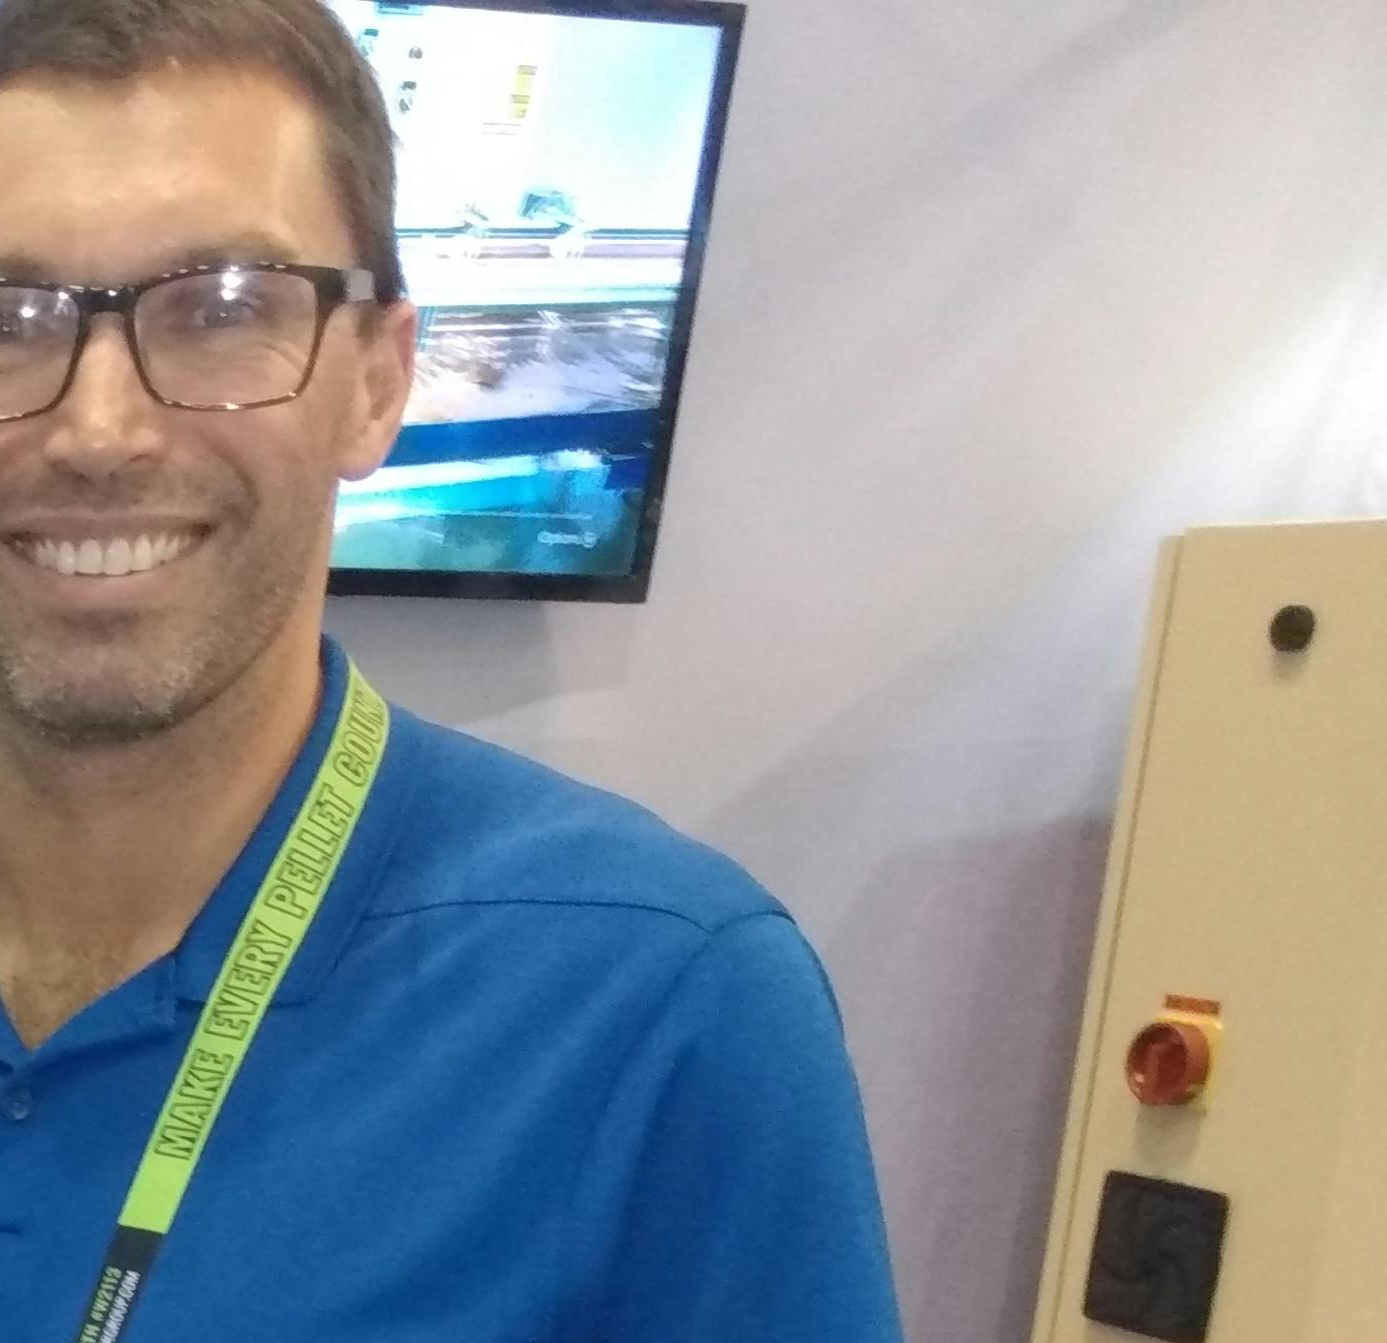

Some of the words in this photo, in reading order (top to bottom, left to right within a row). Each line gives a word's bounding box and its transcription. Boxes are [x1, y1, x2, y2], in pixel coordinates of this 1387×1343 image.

[154, 1048, 233, 1160] MAKE
[205, 920, 294, 1042] EVERY
[264, 783, 356, 919] PELLET
